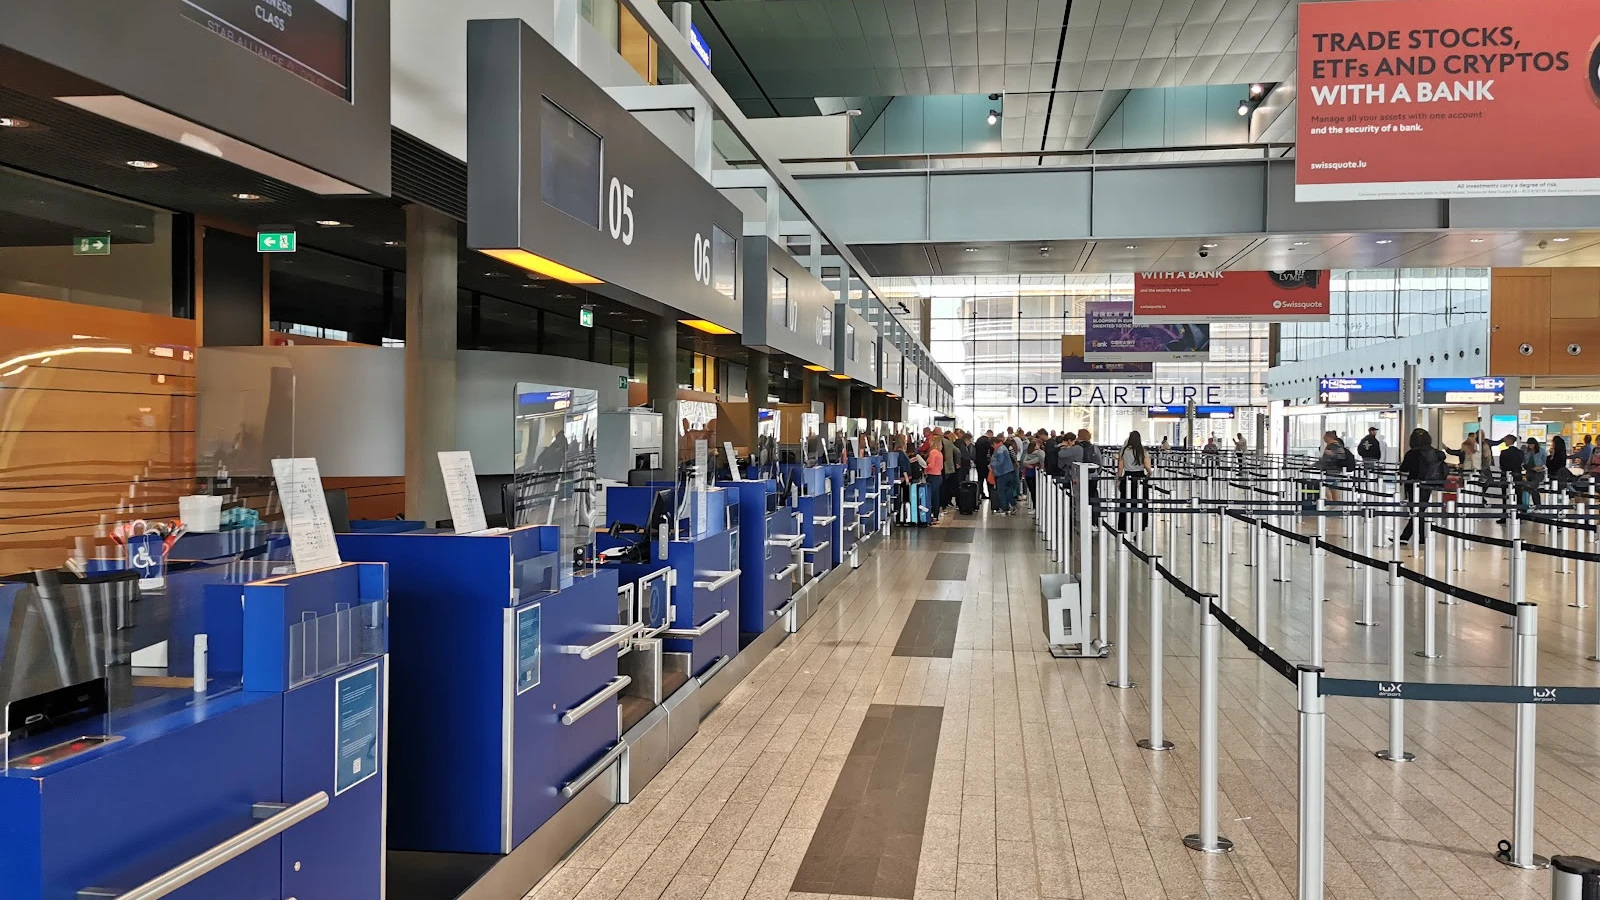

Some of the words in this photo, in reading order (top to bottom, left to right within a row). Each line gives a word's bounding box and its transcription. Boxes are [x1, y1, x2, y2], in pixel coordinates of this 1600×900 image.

[255, 5, 285, 31] CLASS
[207, 20, 235, 41] STAR
[1312, 31, 1400, 52] TRADE
[1408, 26, 1520, 50] STOCKS,
[1312, 58, 1369, 79] ETFs
[1374, 56, 1436, 76] AND
[1443, 51, 1569, 74] CRYPTOS
[1310, 83, 1385, 106] WITH
[1390, 82, 1412, 103] A
[1417, 80, 1494, 103] BANK
[1311, 115, 1345, 124] Manage
[1359, 115, 1378, 123] your
[1380, 113, 1406, 121] assets
[1408, 112, 1427, 120] with
[1448, 111, 1483, 119] account
[1310, 126, 1327, 134] and
[1328, 126, 1343, 134] the
[1345, 125, 1379, 134] security
[1381, 124, 1392, 132] of
[1399, 123, 1424, 132] bank.
[1310, 160, 1367, 170] swissquote.lu
[609, 176, 634, 246] 05
[694, 232, 711, 286] 06
[1141, 271, 1174, 279] WITH
[1176, 271, 1186, 279] A
[1188, 271, 1224, 279] BANK
[1282, 300, 1323, 310] Swissquote
[1022, 386, 1221, 404] DEPARTURE
